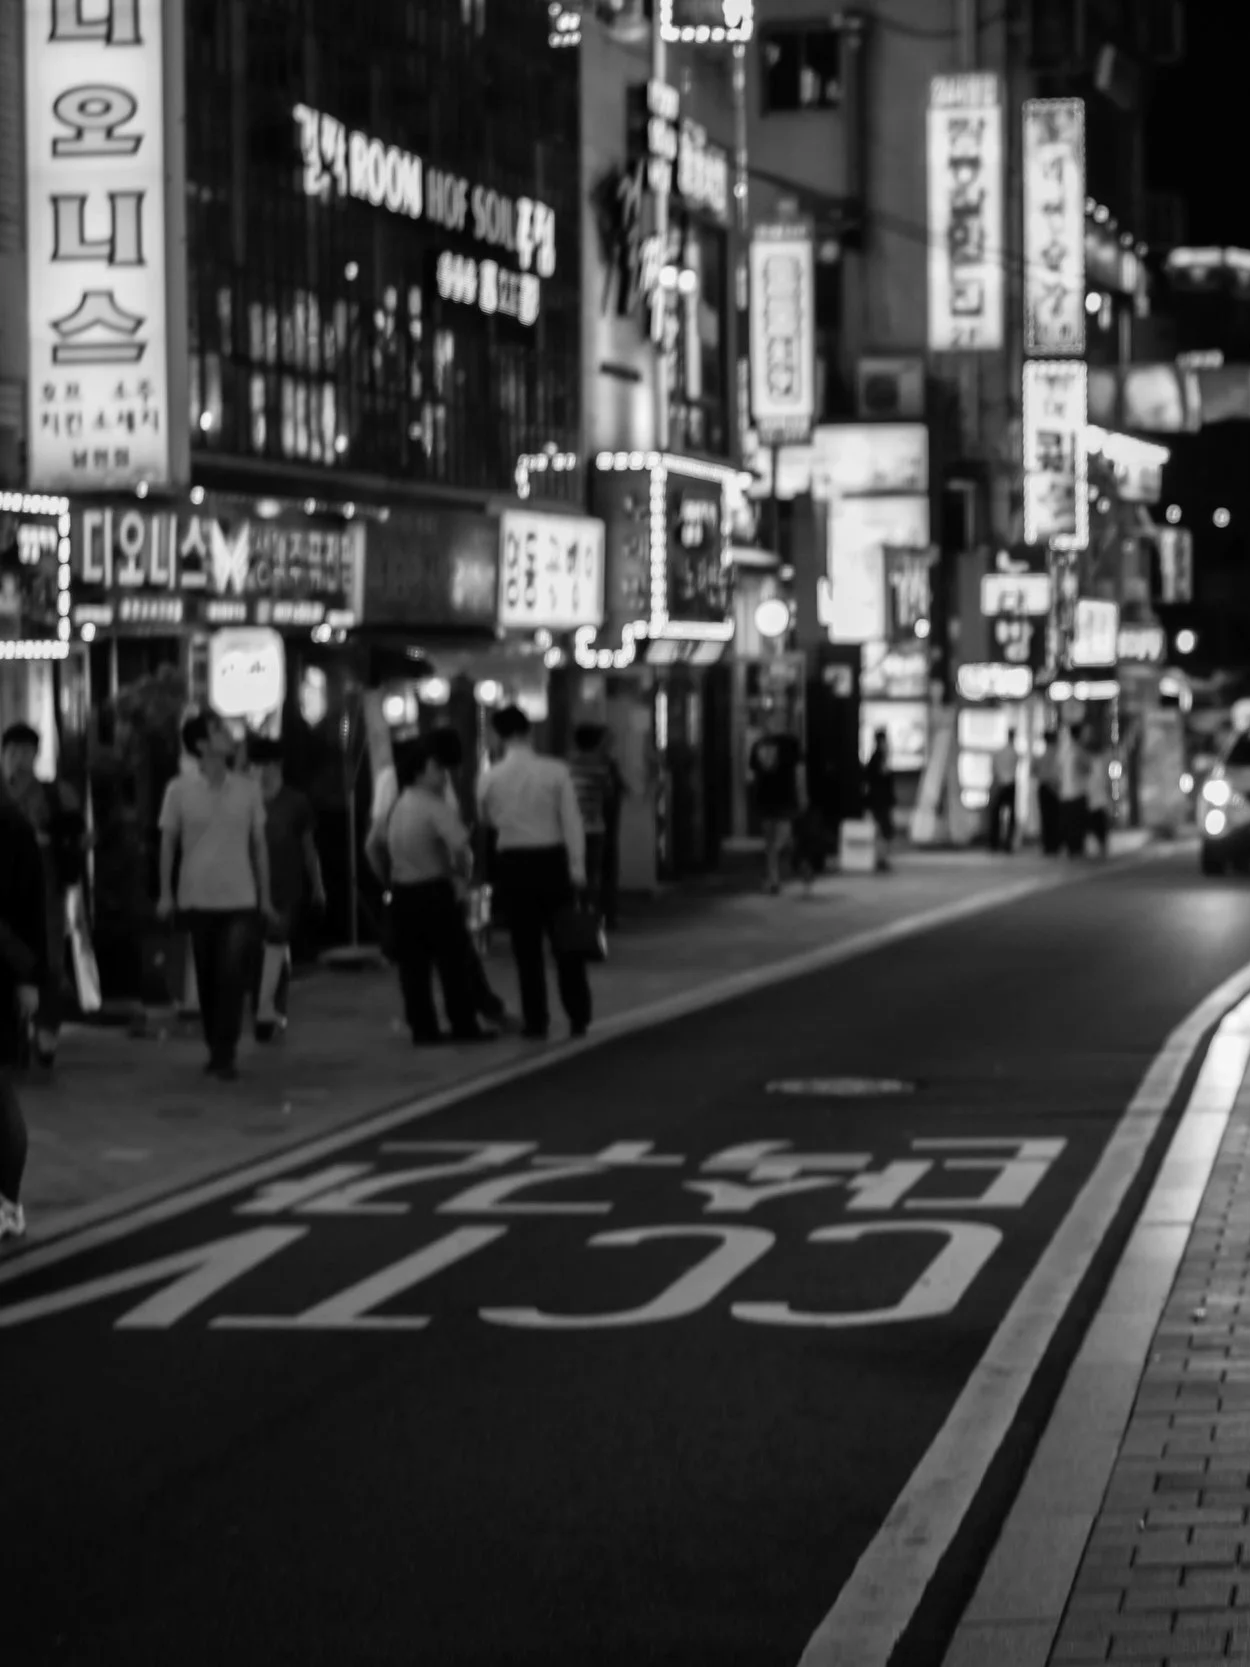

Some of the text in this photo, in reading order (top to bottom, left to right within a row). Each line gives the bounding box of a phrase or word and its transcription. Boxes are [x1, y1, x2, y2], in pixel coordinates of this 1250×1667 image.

[348, 130, 423, 219] ROOM
[81, 508, 209, 589] 디오니스
[234, 1136, 1067, 1215] 단속구간
[0, 1220, 1003, 1331] CCTV
